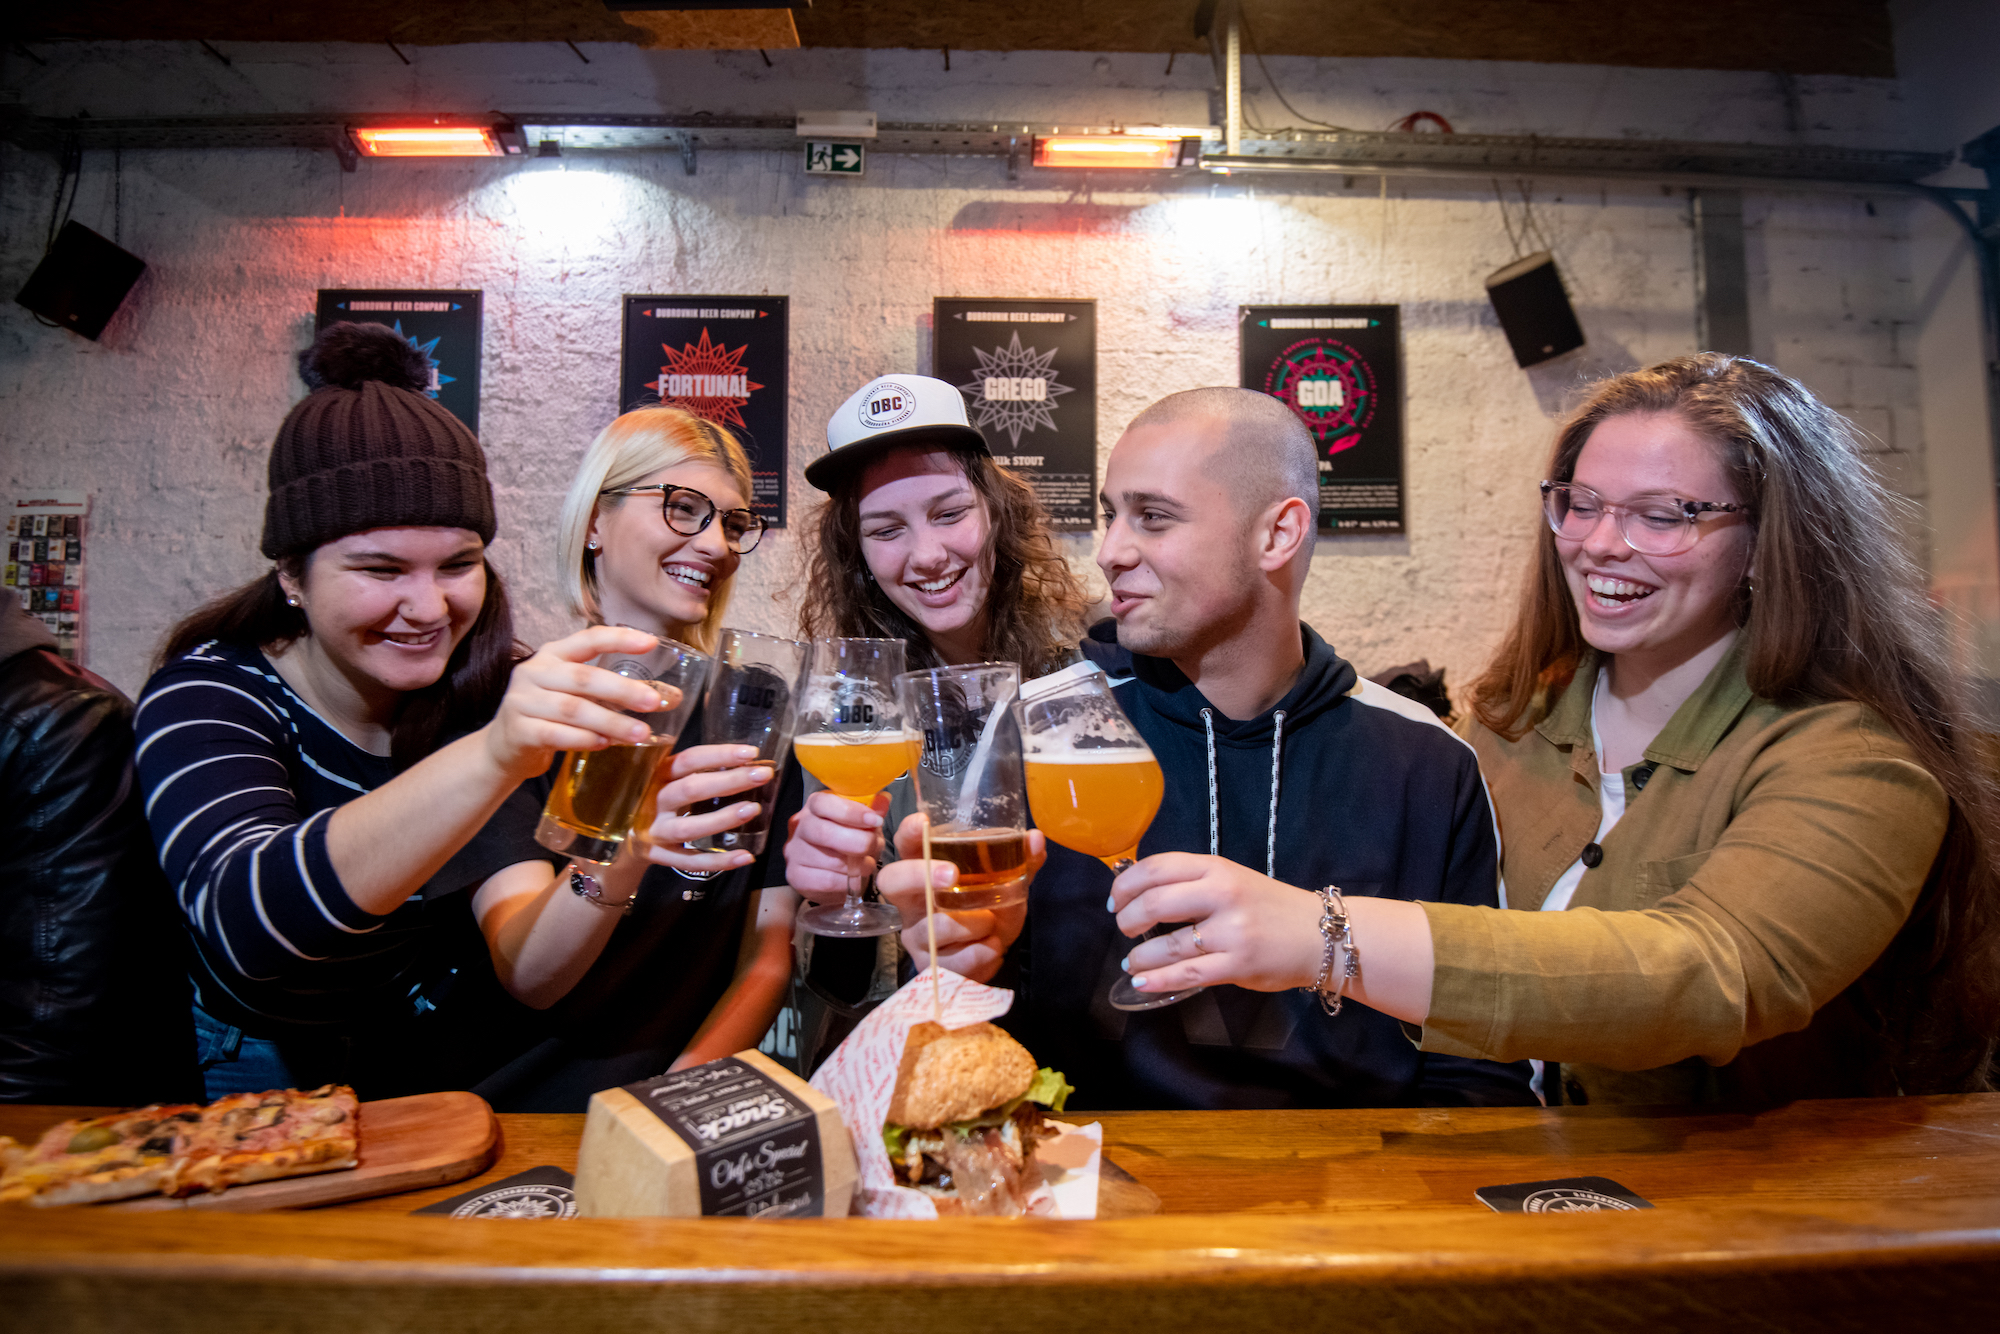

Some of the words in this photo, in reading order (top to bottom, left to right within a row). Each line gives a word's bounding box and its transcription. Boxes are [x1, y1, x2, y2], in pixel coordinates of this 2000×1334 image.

[350, 301, 392, 311] DUBROVNIK
[393, 301, 412, 311] BEER
[414, 302, 450, 312] COMPANY
[655, 308, 699, 318] DUBROVNIK
[700, 308, 719, 318] BEER
[720, 308, 756, 319] COMPANY
[966, 311, 1009, 322] DUBROVNIK
[1010, 312, 1029, 322] BEER
[1030, 312, 1066, 323] COMPANY
[658, 374, 751, 398] FORTUNAL
[984, 377, 1047, 401] GREGO
[1297, 380, 1344, 407] GOA
[870, 396, 902, 416] DBC
[1012, 456, 1045, 467] STOUT
[738, 684, 776, 709] DBC
[839, 705, 873, 724] DBC
[699, 1098, 787, 1141] Snack
[753, 1139, 809, 1169] Special
